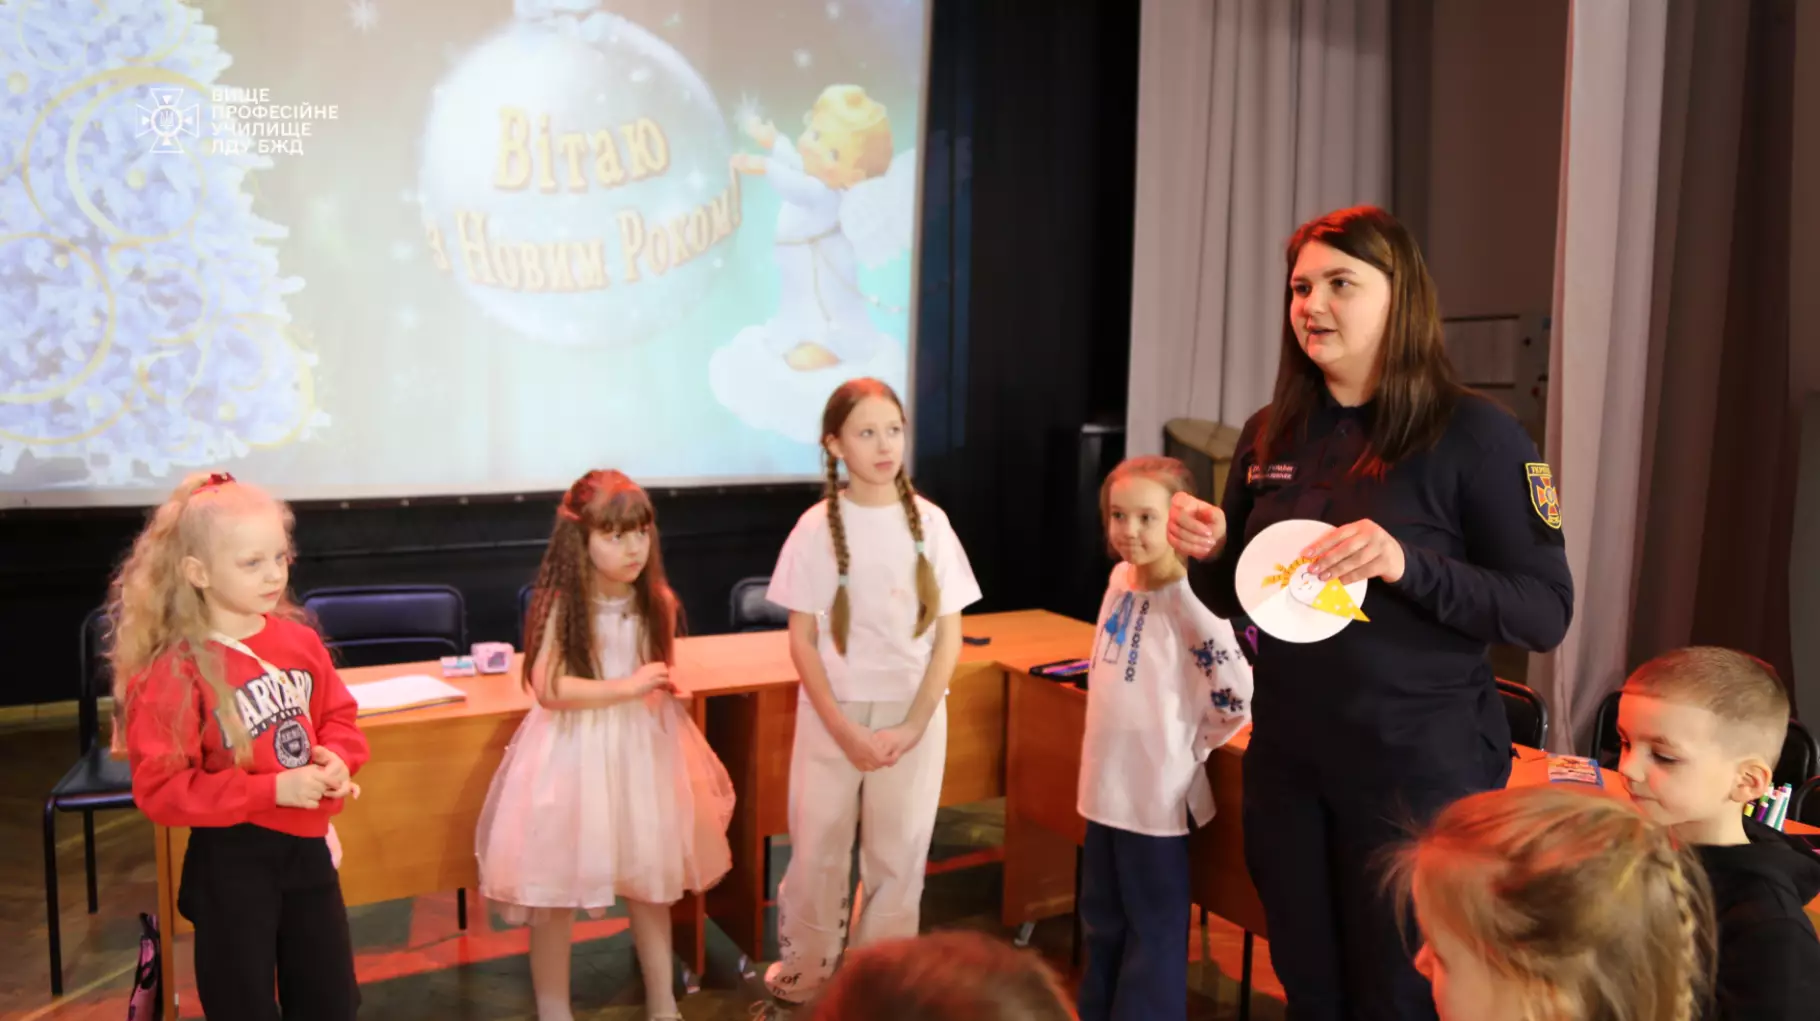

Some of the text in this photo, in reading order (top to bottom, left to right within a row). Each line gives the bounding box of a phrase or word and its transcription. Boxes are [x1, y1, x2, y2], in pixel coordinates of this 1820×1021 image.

[494, 104, 671, 194] Вітаю
[455, 210, 611, 293] Новим
[213, 668, 313, 749] ARVARD
